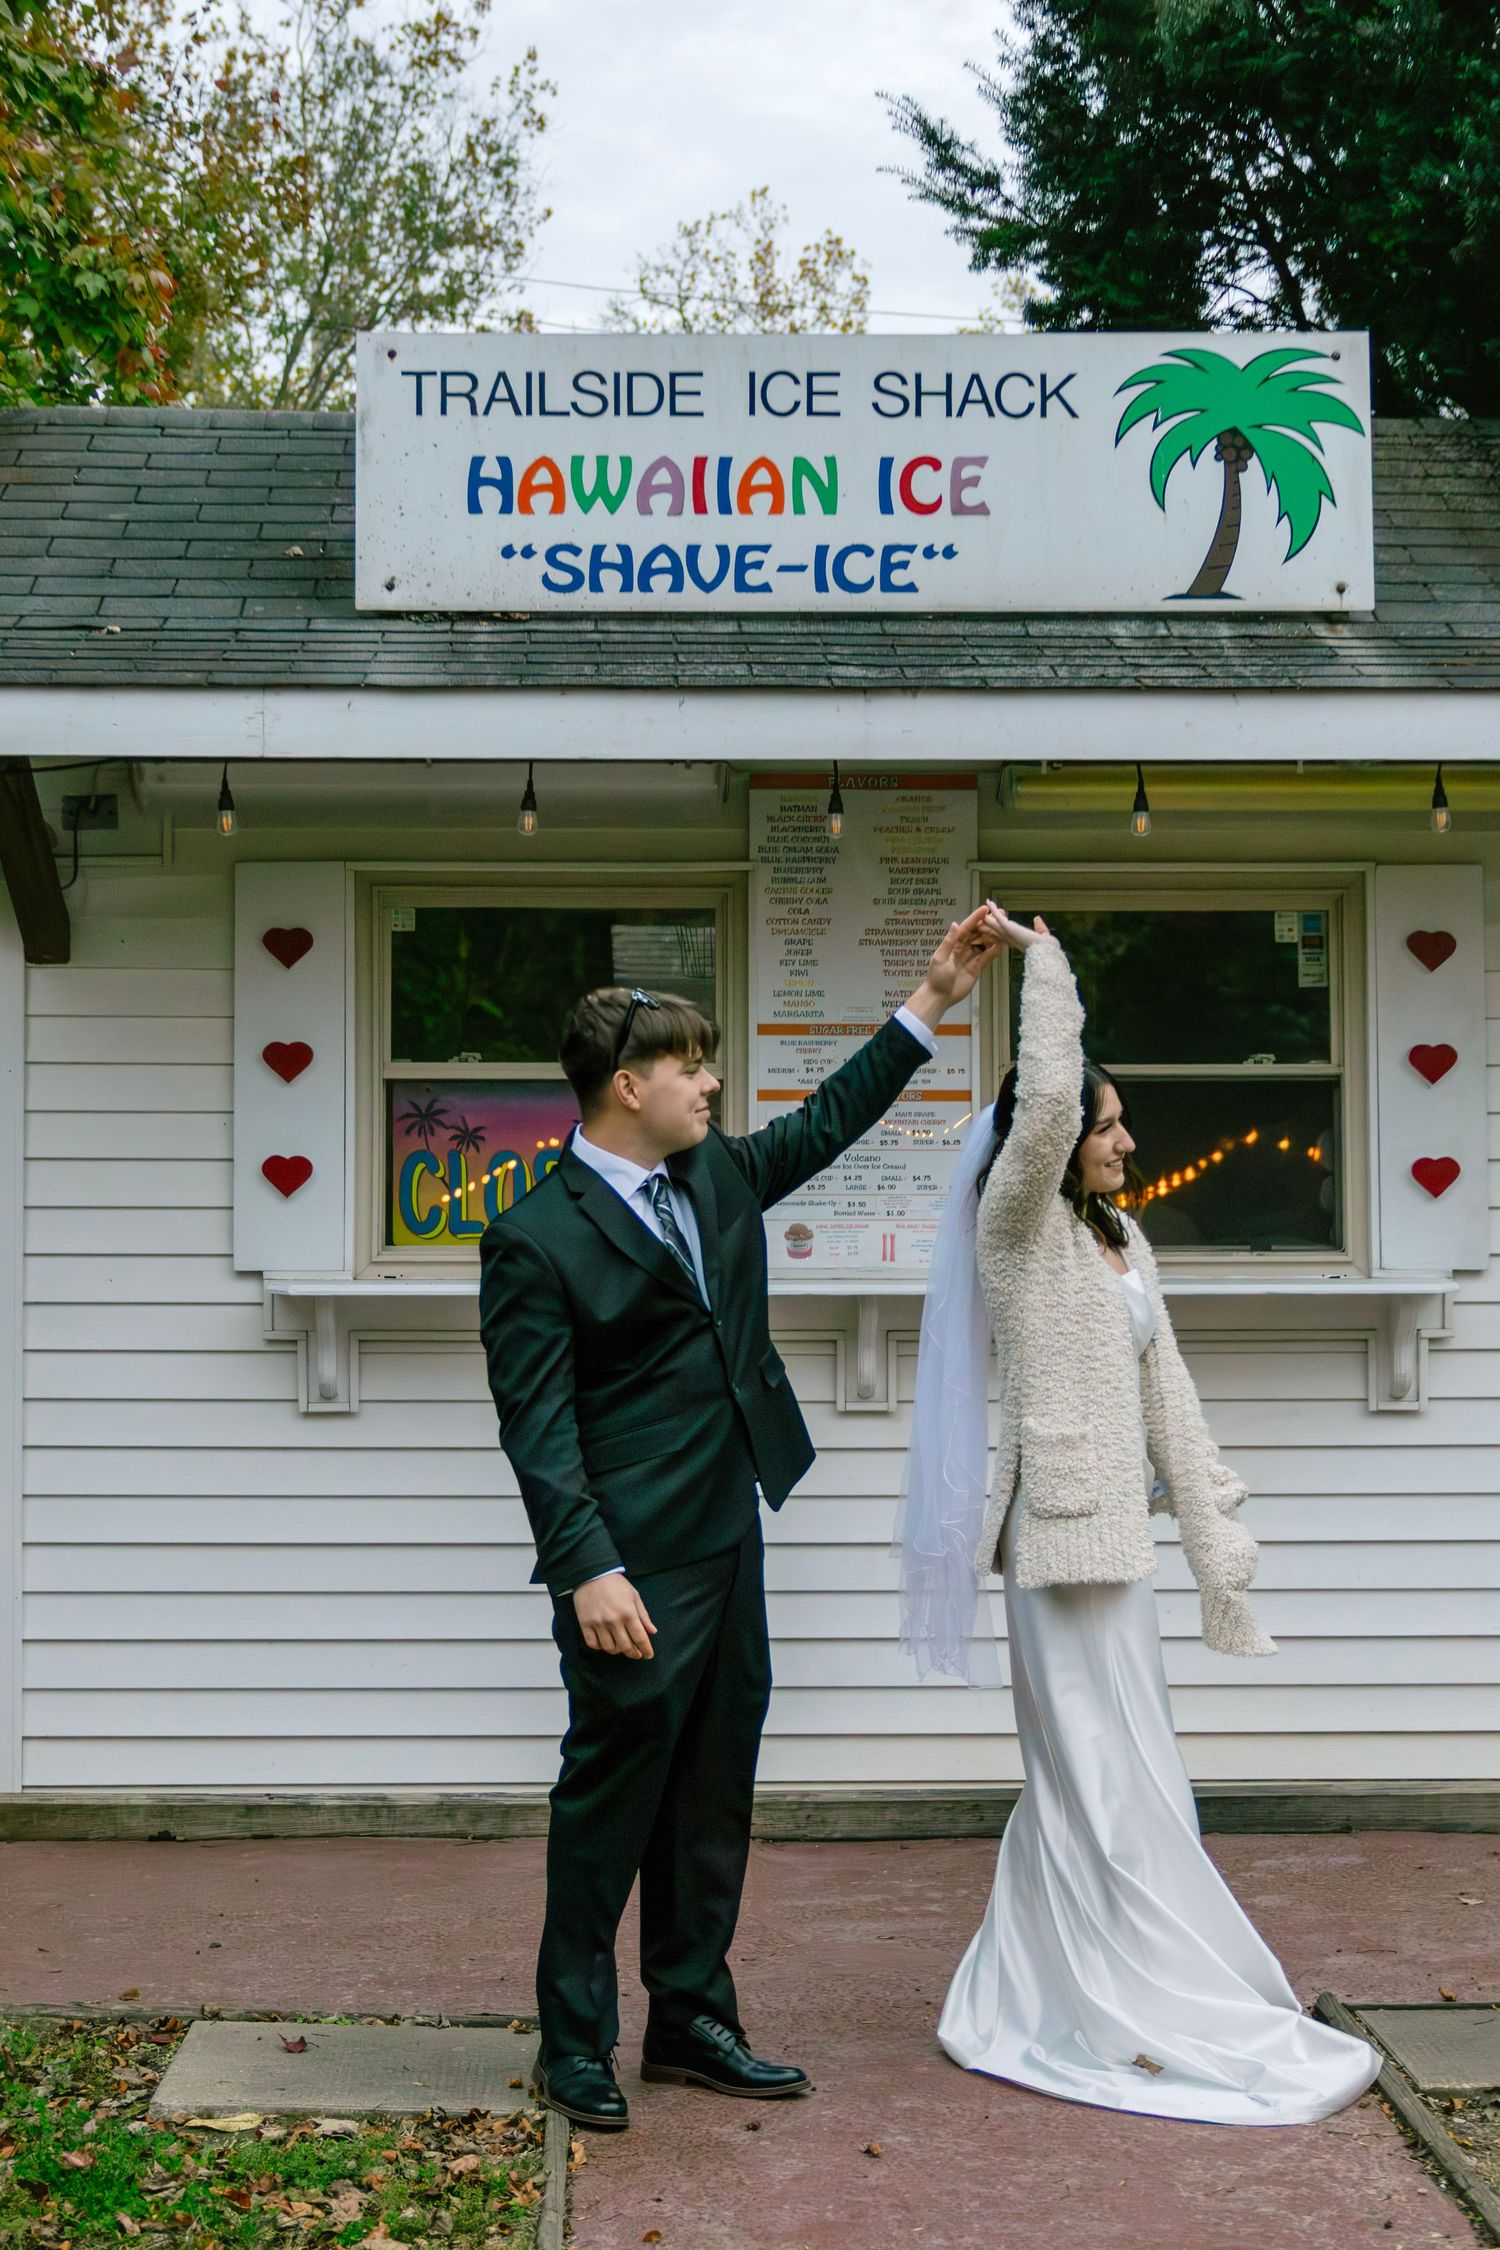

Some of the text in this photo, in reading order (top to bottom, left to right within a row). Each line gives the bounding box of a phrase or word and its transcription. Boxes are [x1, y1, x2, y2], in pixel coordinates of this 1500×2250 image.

[400, 369, 1080, 420] TRAILSIDE ICE SHACK
[466, 454, 991, 516] HAWAIIAN ICE
[760, 856, 783, 864] BLUE
[768, 897, 828, 905] CHERRY COLA
[873, 898, 956, 906] SOUR GREEN APPLE
[788, 907, 810, 915] COLA
[766, 918, 832, 926] COTTON CANDY
[884, 918, 944, 926] STRAWBERRY
[864, 928, 924, 936] STRAWBERRY
[784, 938, 814, 946] GRAPE
[858, 938, 918, 946] STRAWBERRY
[784, 948, 813, 956] JOKER
[880, 949, 919, 957] TAHITIAN
[779, 959, 818, 967] KEY LIME
[790, 969, 808, 977] KIWI
[773, 990, 825, 998] LEMON LIME
[783, 1000, 816, 1008] MANGO
[773, 1010, 825, 1018] MARGARITA
[809, 1026, 844, 1034] SUGAR
[846, 1026, 872, 1034] FREE
[844, 1154, 881, 1162] Volcano
